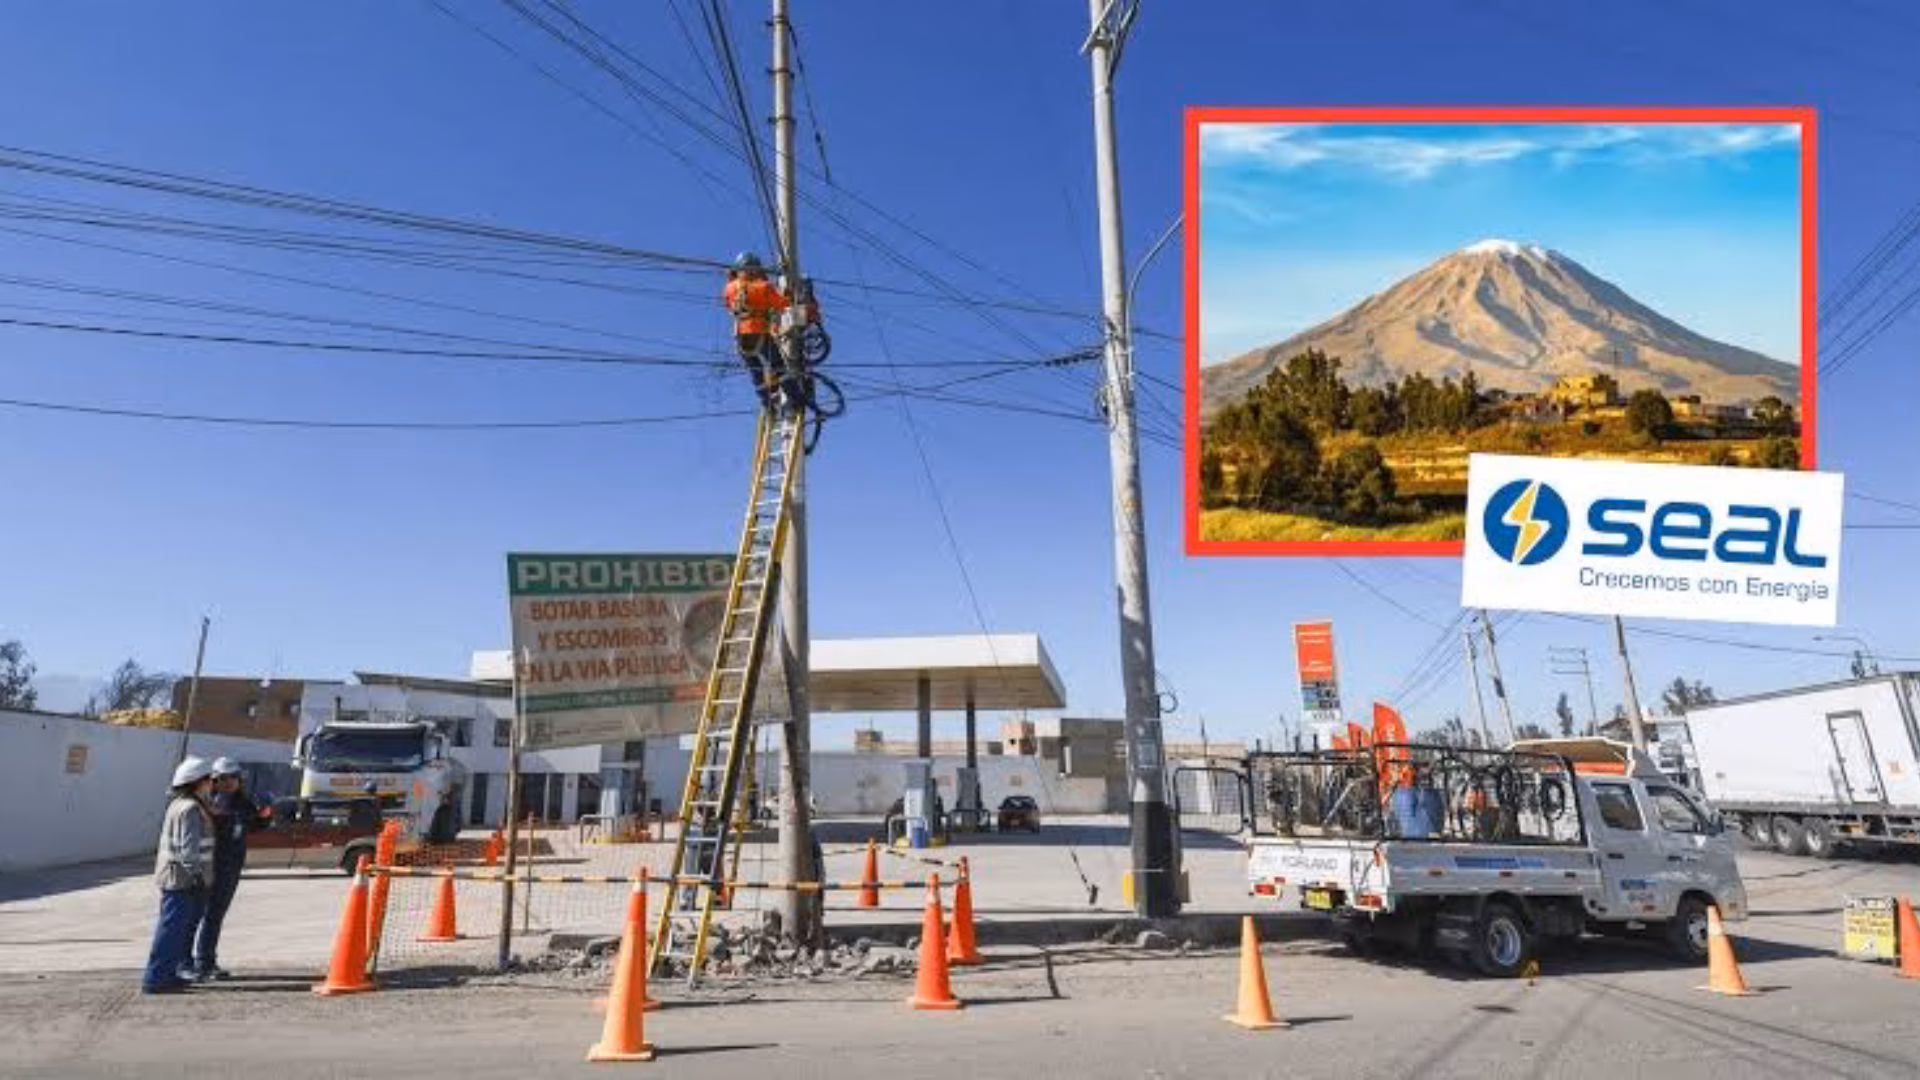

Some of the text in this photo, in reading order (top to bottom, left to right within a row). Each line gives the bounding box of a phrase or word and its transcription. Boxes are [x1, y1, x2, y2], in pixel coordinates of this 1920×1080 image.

[530, 597, 669, 621] BOTAR BASURA
[538, 627, 668, 651] Y ESCOMBROS
[551, 660, 573, 682] LA
